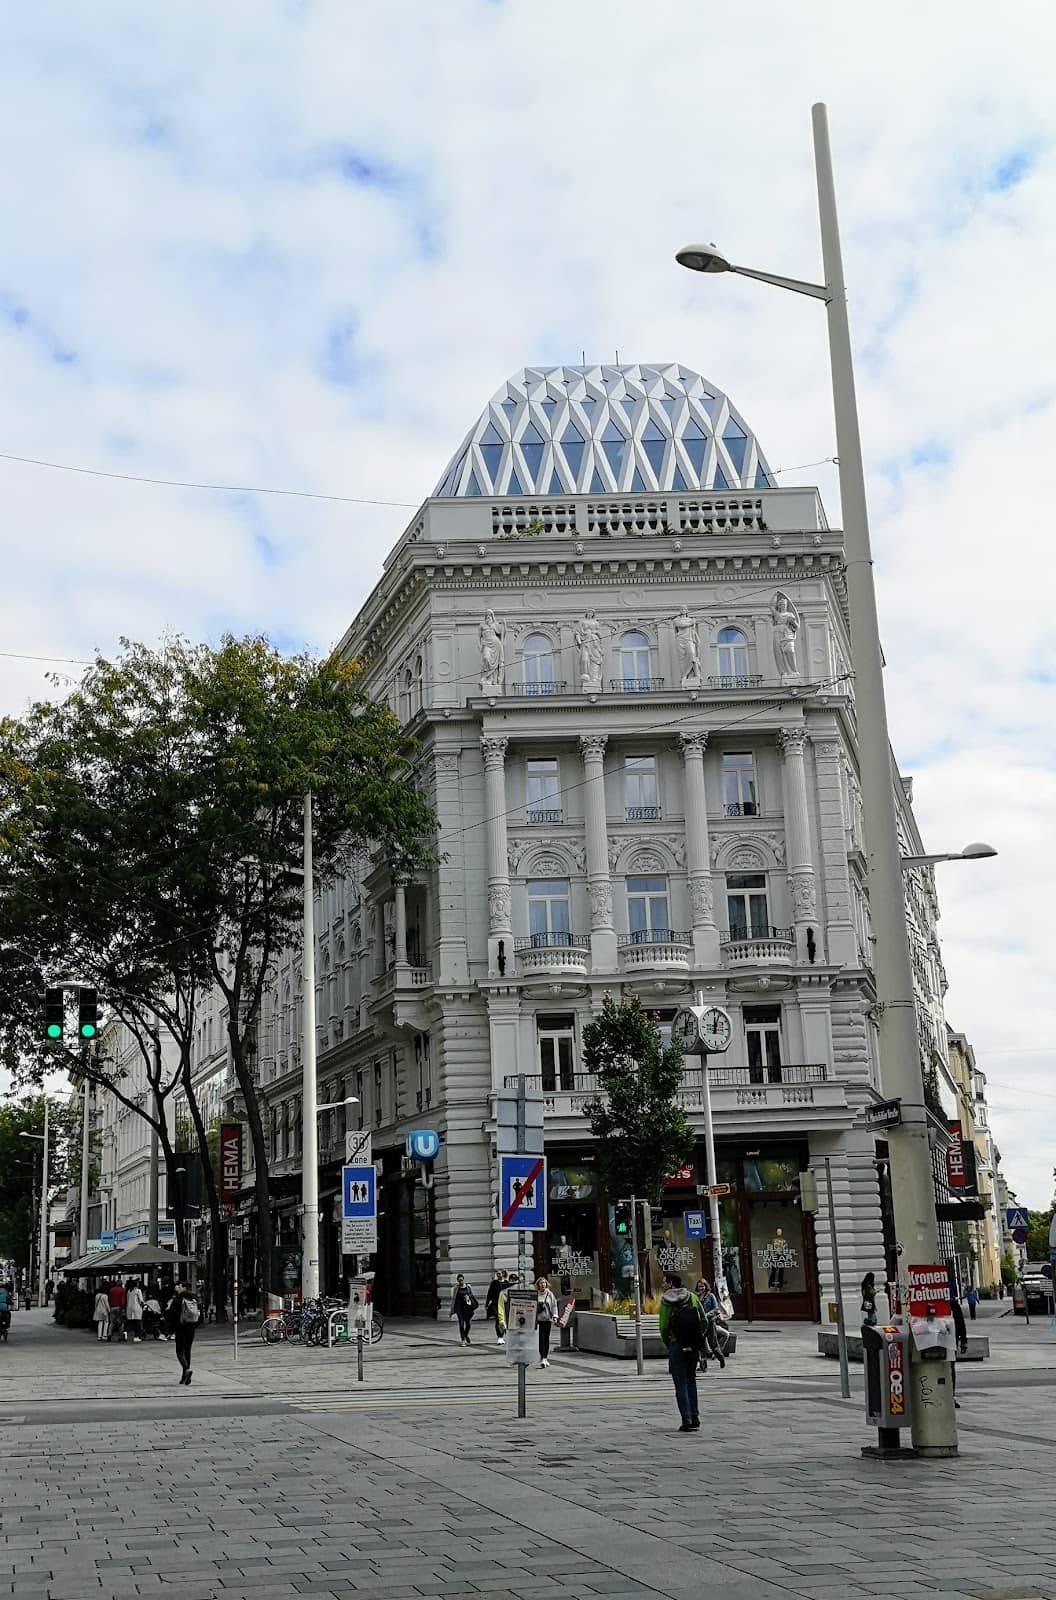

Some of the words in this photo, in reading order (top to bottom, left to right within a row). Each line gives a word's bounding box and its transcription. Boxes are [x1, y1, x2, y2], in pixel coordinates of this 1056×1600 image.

[417, 1135, 434, 1157] U
[950, 1131, 964, 1176] HEMA
[223, 1138, 239, 1190] HEMA
[909, 1271, 949, 1286] Kronen
[909, 1286, 951, 1302] Zeitung
[335, 1325, 345, 1337] P
[890, 1370, 904, 1415] oe24
